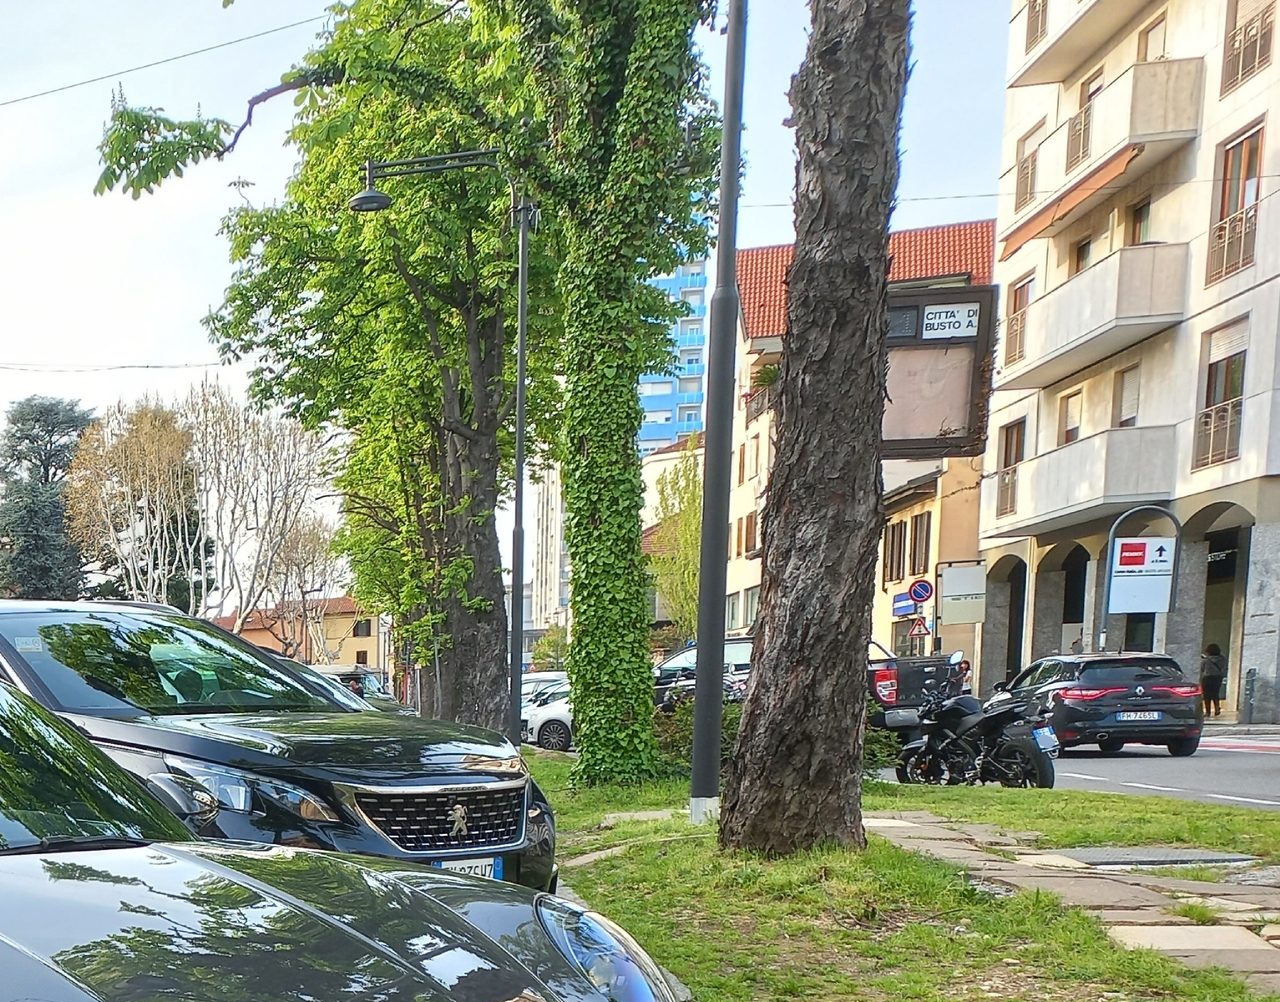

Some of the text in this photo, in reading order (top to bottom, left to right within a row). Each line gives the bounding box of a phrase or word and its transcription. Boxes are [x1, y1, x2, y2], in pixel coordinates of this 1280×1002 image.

[926, 309, 978, 320] CITTA' DI
[925, 320, 961, 331] BUSTO
